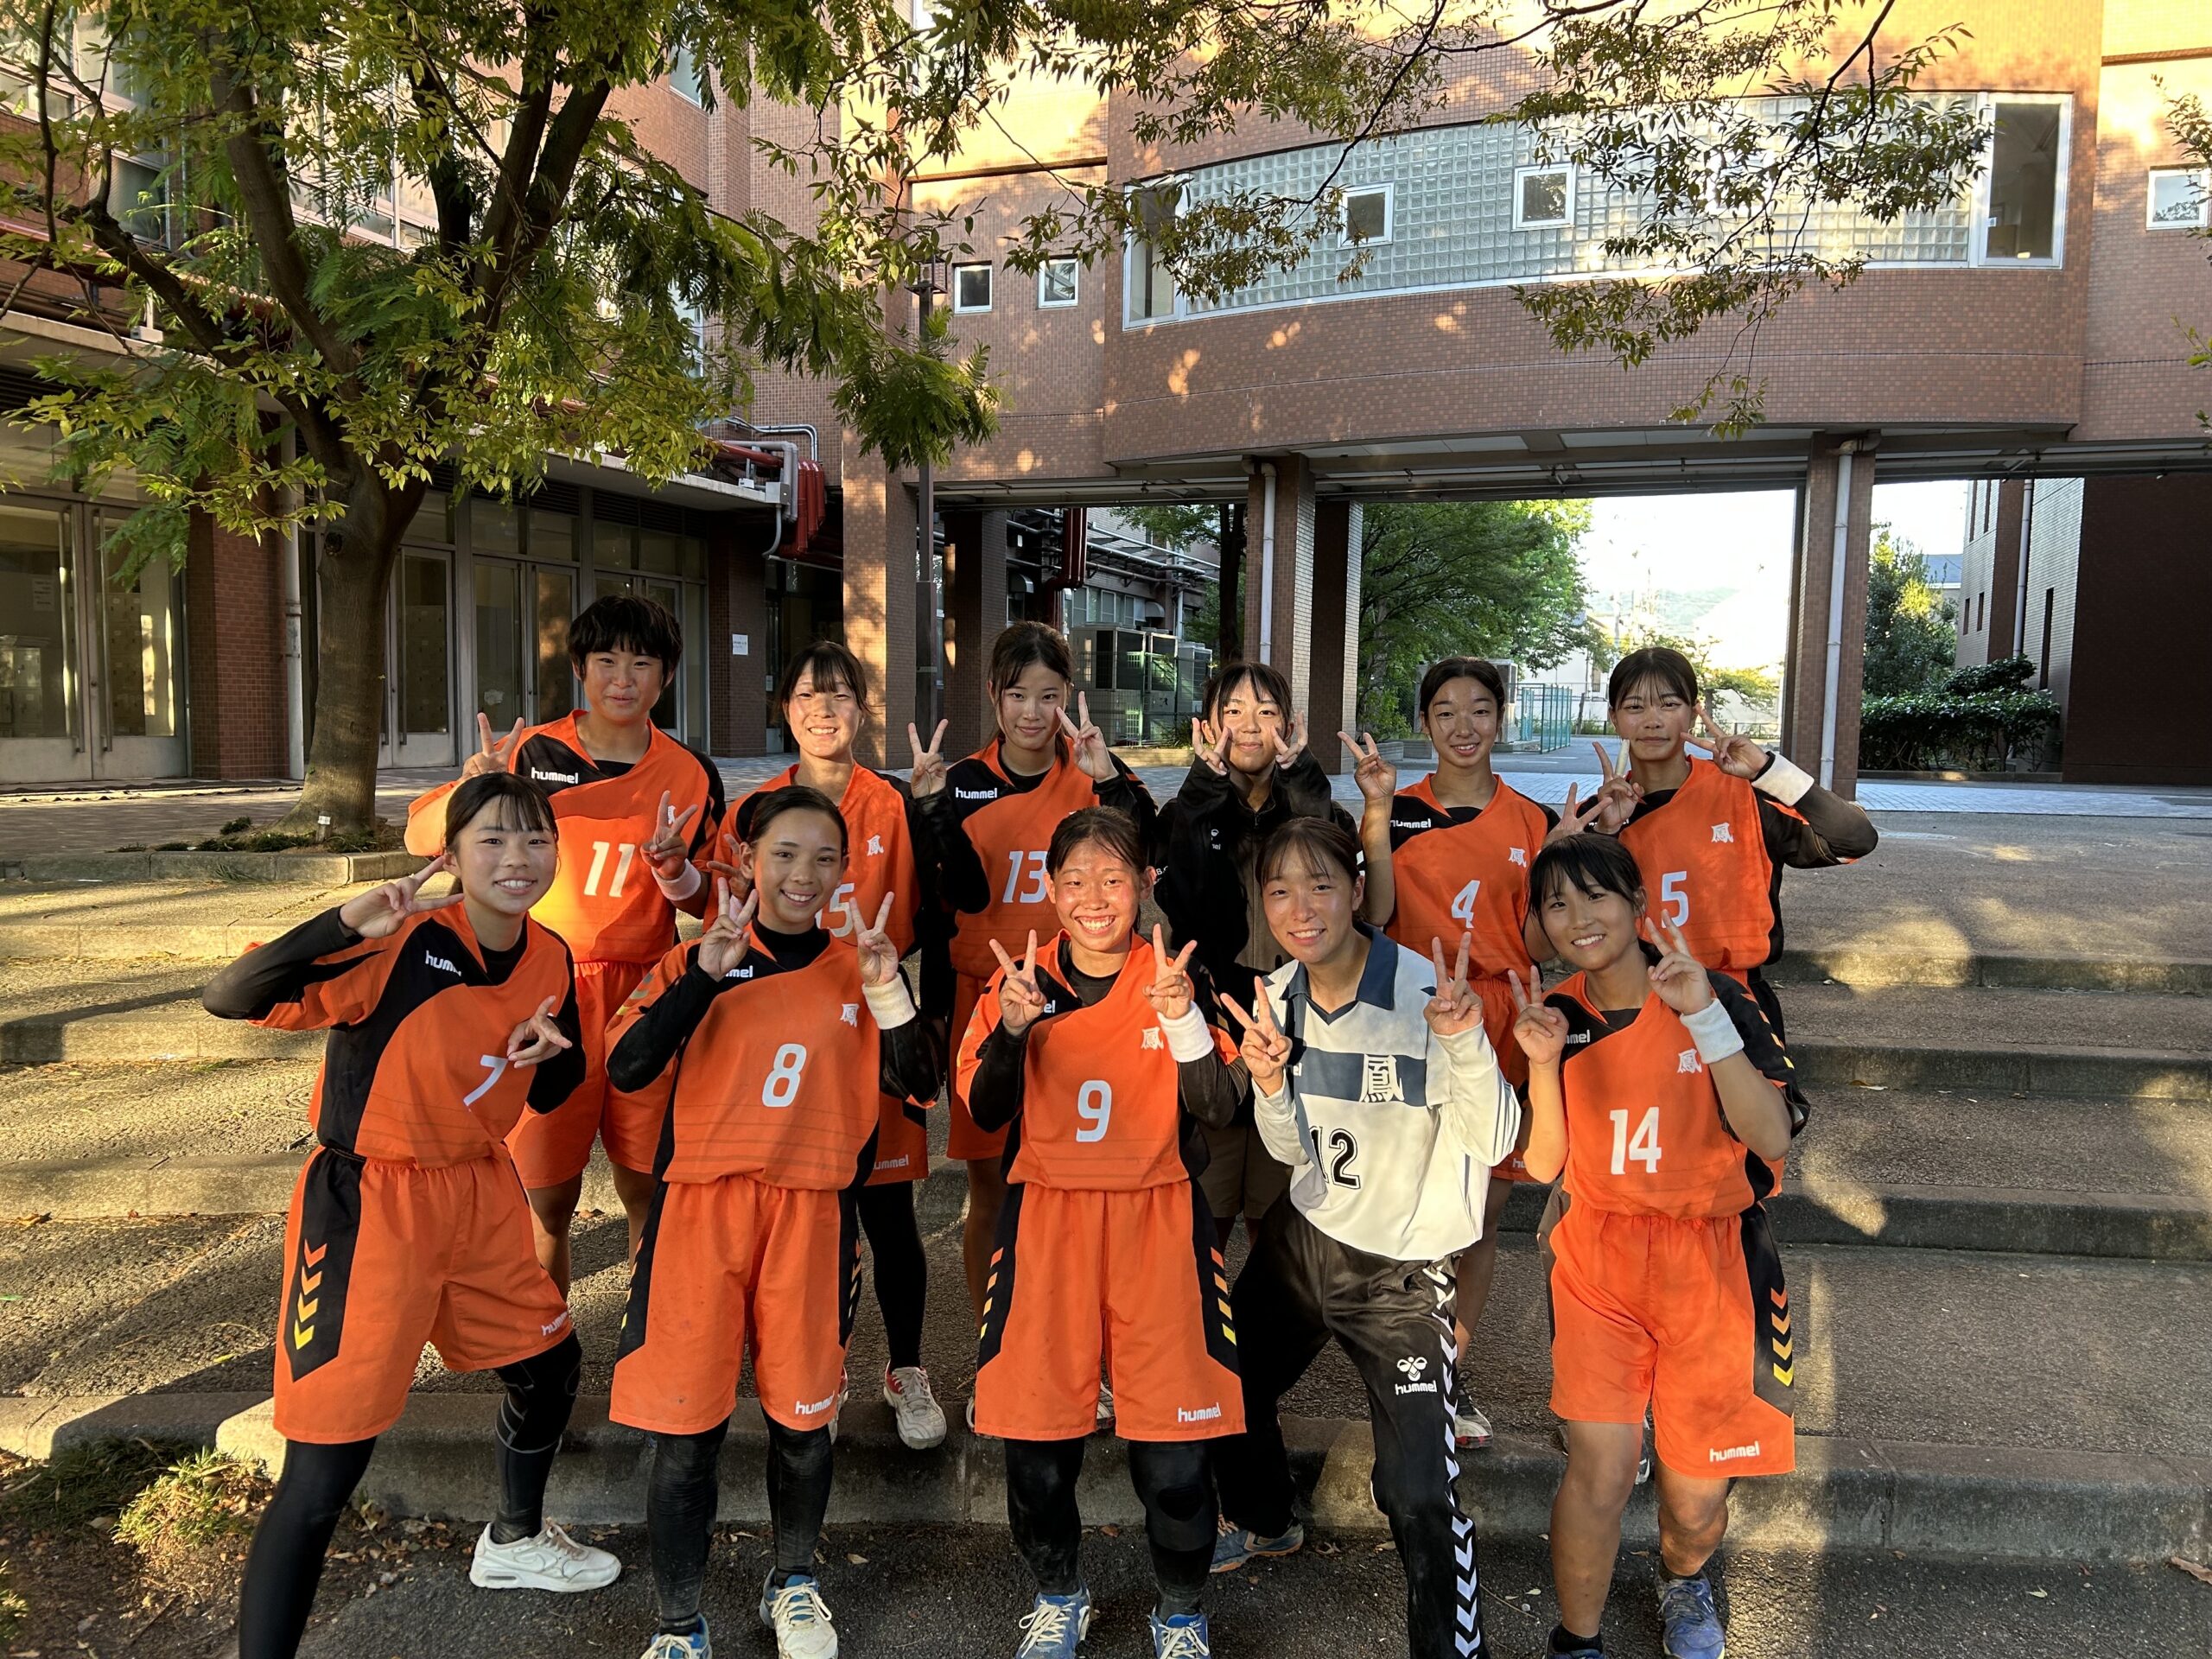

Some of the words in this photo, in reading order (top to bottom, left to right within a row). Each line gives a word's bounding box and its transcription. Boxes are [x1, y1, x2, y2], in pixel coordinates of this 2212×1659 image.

[531, 766, 579, 785] hummel
[955, 786, 998, 799] hummel
[583, 841, 635, 898] 11
[1001, 850, 1049, 903] 13
[1451, 880, 1481, 928] 4
[1662, 870, 1689, 928] 5
[424, 950, 462, 977] hum
[725, 965, 753, 978] mel
[1566, 1029, 1591, 1044] mel
[463, 1054, 509, 1109] 7
[761, 1043, 807, 1108] 8
[1359, 1053, 1405, 1103] 鳳
[1075, 1079, 1112, 1142] 9
[873, 1154, 909, 1171] ummel
[1309, 1125, 1361, 1190] 12
[1609, 1106, 1662, 1175] 14
[1395, 1379, 1438, 1396] hummel
[1178, 1402, 1222, 1423] hummel
[1709, 1440, 1760, 1462] hummel
